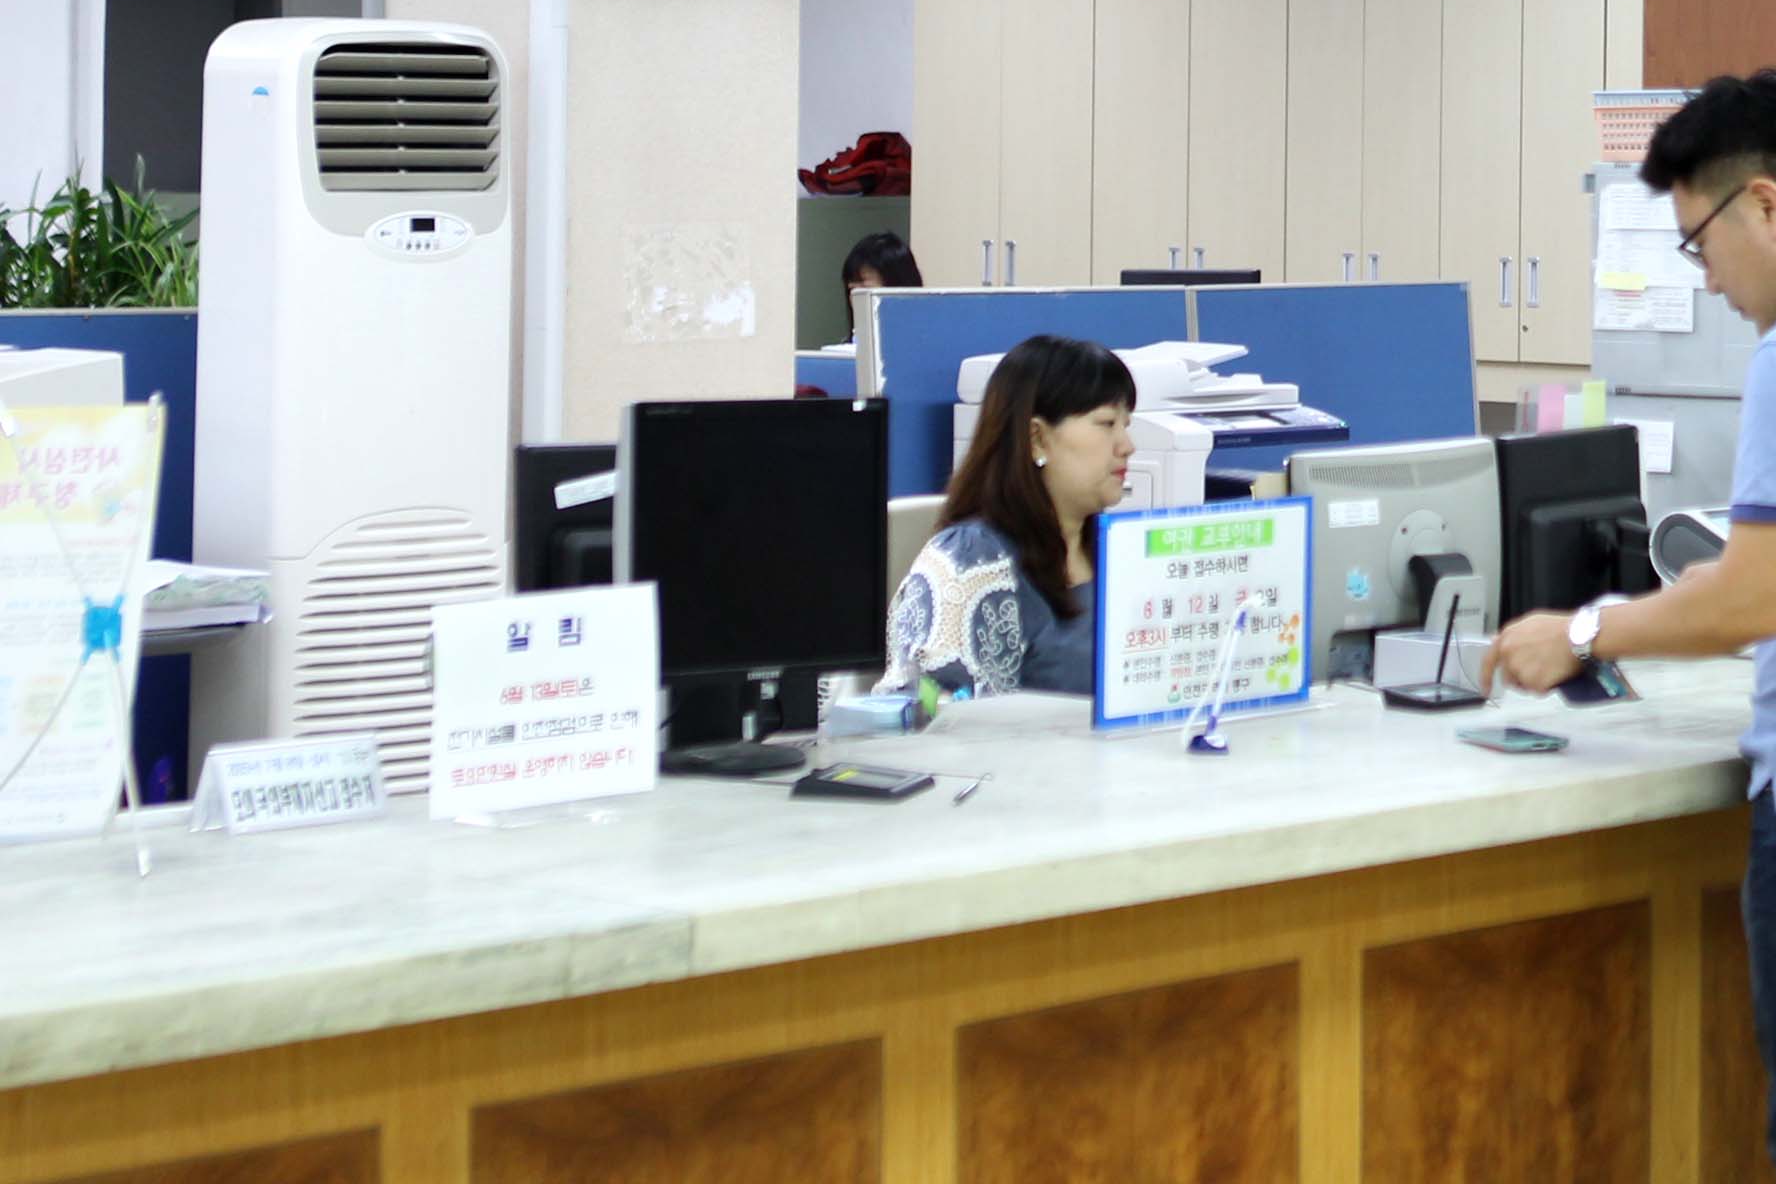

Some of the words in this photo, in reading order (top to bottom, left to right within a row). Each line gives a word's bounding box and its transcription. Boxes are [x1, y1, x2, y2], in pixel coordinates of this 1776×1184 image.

[1165, 562, 1190, 580] 오늘
[1193, 555, 1250, 578] 접수하시면
[1142, 597, 1154, 619] 6
[1161, 597, 1174, 618] 월
[1187, 596, 1203, 615] 12
[506, 622, 531, 653] 알
[557, 617, 583, 648] 림
[1170, 624, 1193, 642] 부터
[1197, 620, 1220, 640] 수령
[499, 683, 524, 706] 6월
